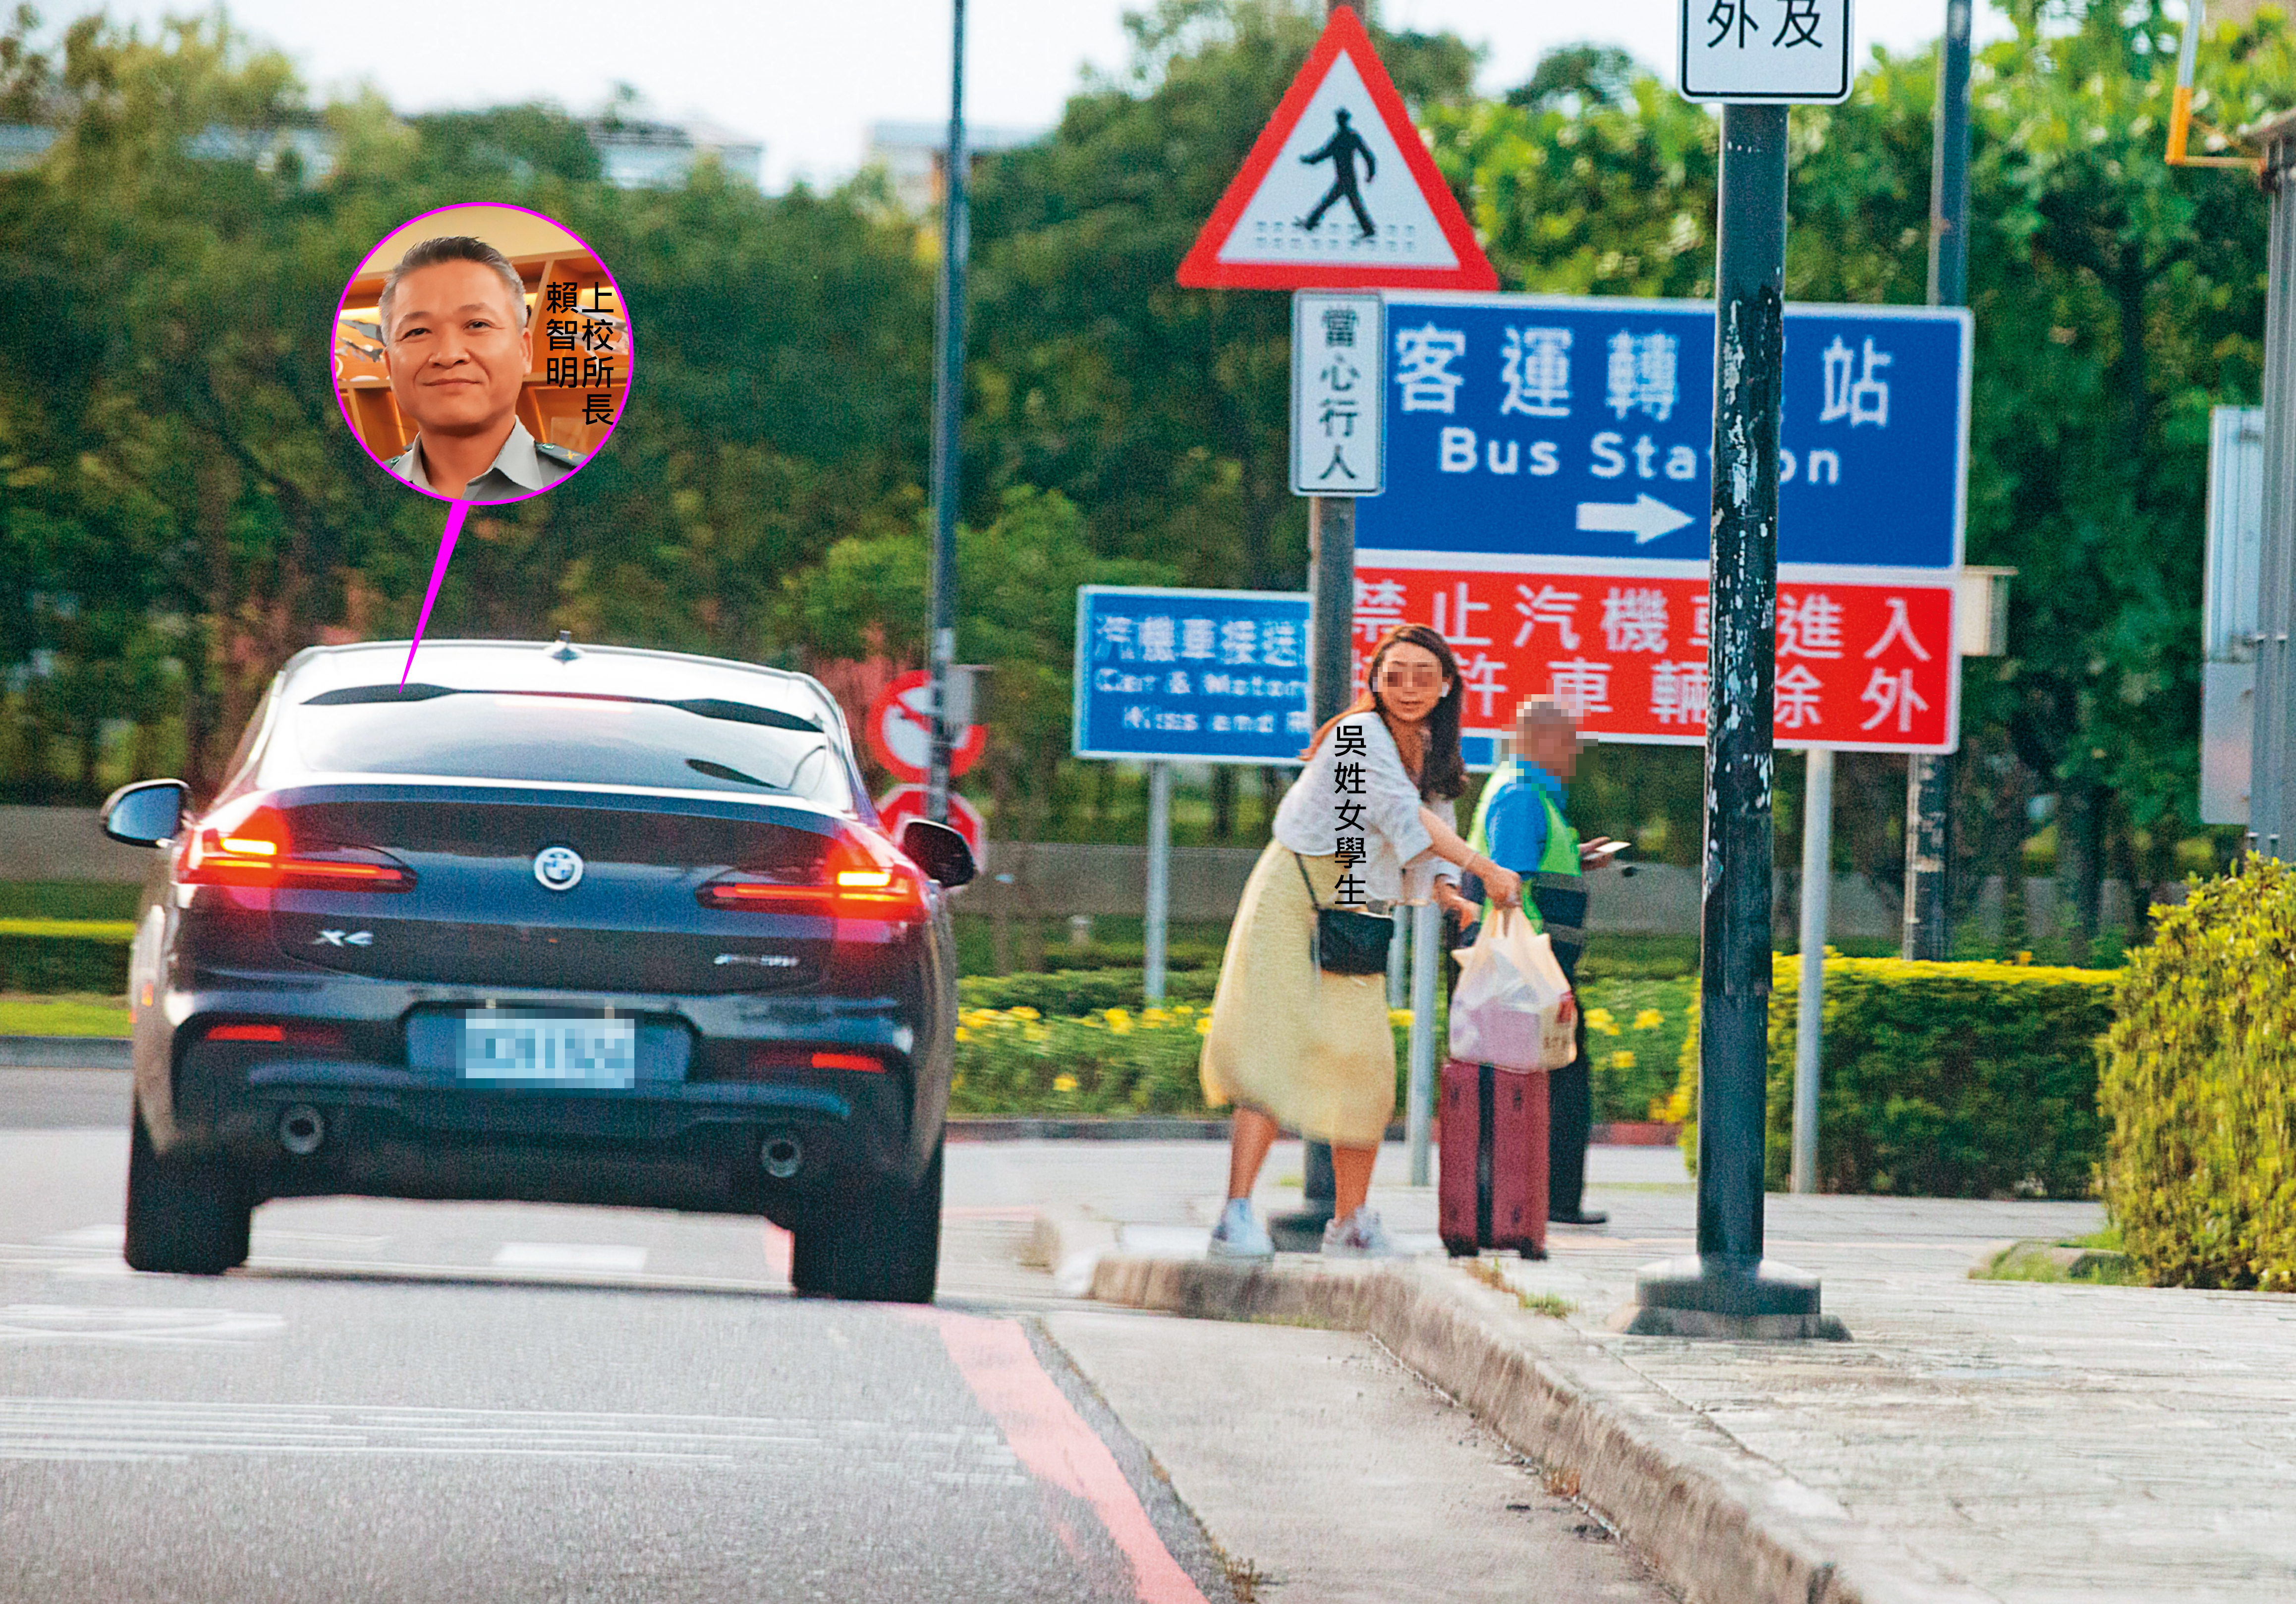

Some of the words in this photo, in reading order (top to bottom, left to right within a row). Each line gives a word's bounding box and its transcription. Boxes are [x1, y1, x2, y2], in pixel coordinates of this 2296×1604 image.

[1707, 0, 1823, 49] 外及
[1317, 306, 1359, 480] 當心行人
[1394, 321, 1894, 429] 客運轉站
[1440, 426, 1560, 477] Bus
[1589, 430, 1841, 486] Staon
[1094, 614, 1312, 667] 汽機車接送
[1353, 577, 1932, 661] 禁止汽機進入
